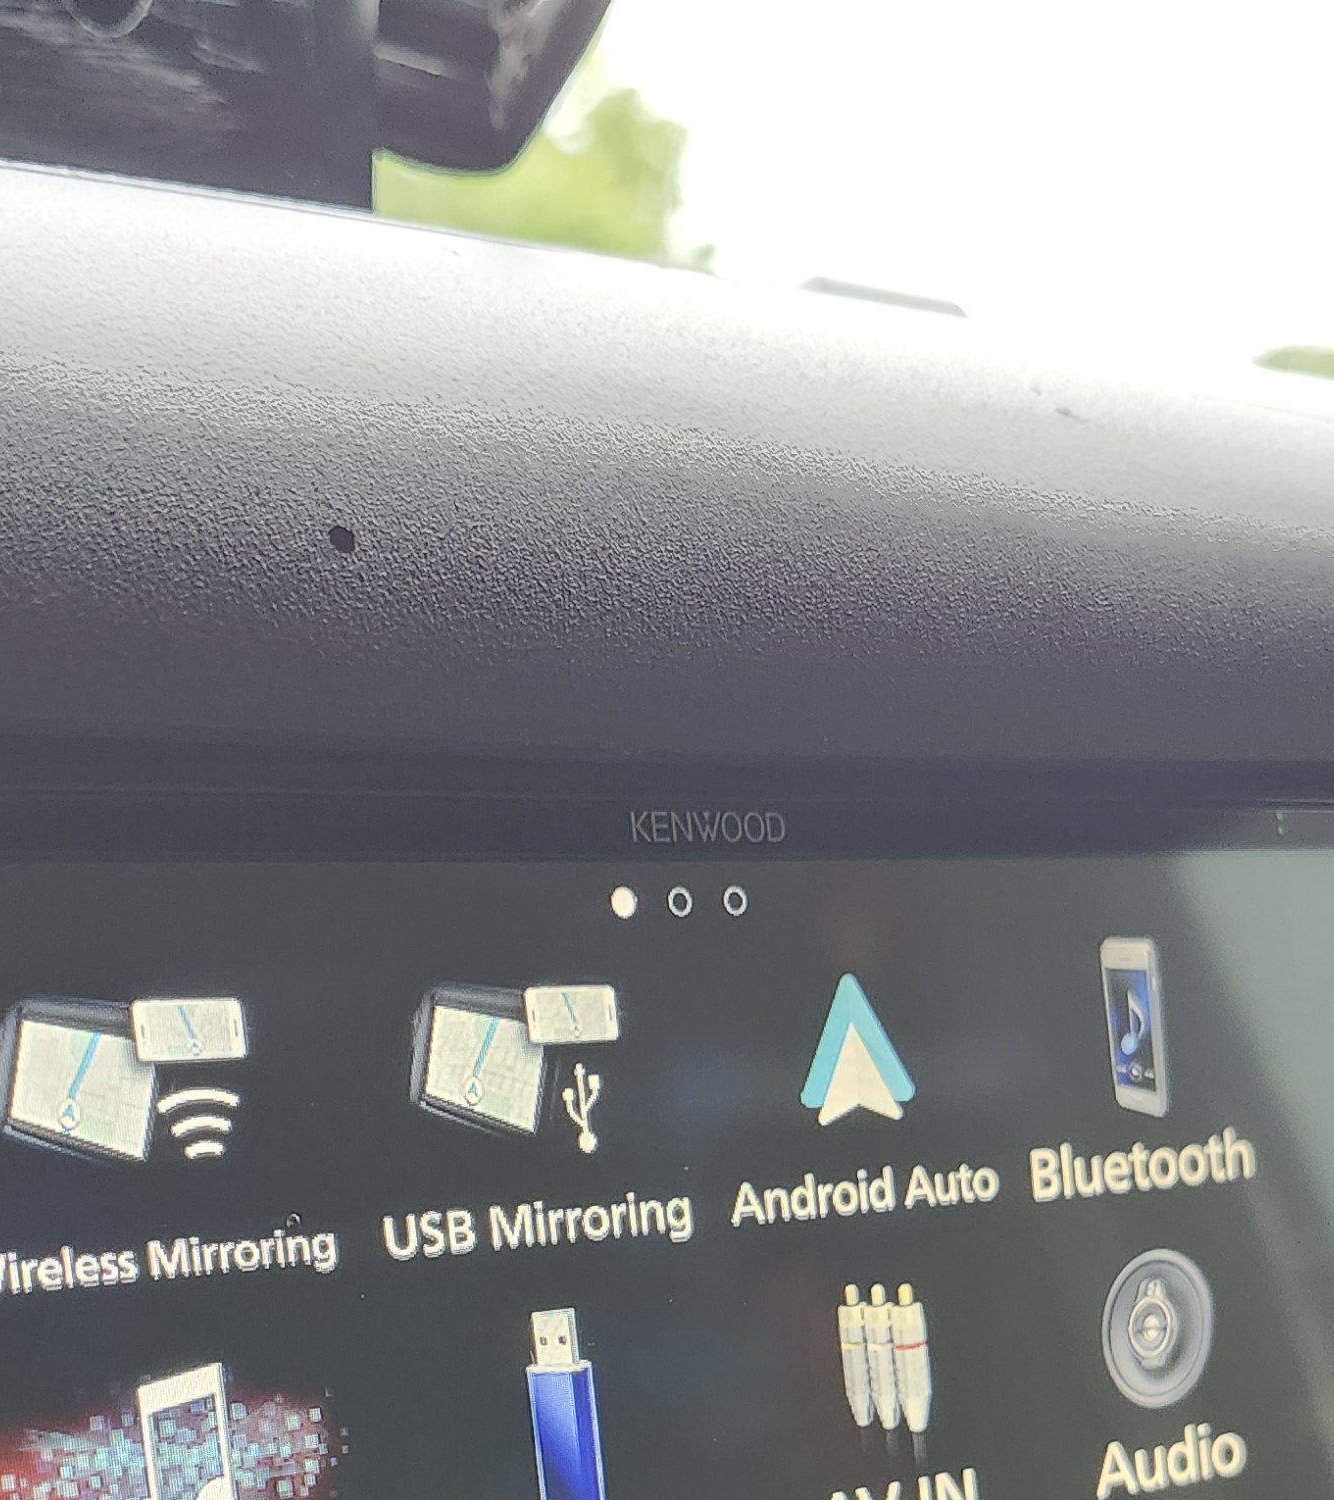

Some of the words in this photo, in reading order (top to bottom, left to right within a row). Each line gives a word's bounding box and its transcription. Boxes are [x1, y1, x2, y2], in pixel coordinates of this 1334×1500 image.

[629, 811, 786, 844] KENWOOD
[731, 1166, 895, 1226] Android
[904, 1160, 1000, 1209] Auto
[1028, 1127, 1257, 1203] Bluetooth
[146, 1227, 338, 1281] Mirroring
[383, 1203, 475, 1262] USB
[490, 1190, 693, 1251] Mirroring
[1096, 1423, 1247, 1500] Audio
